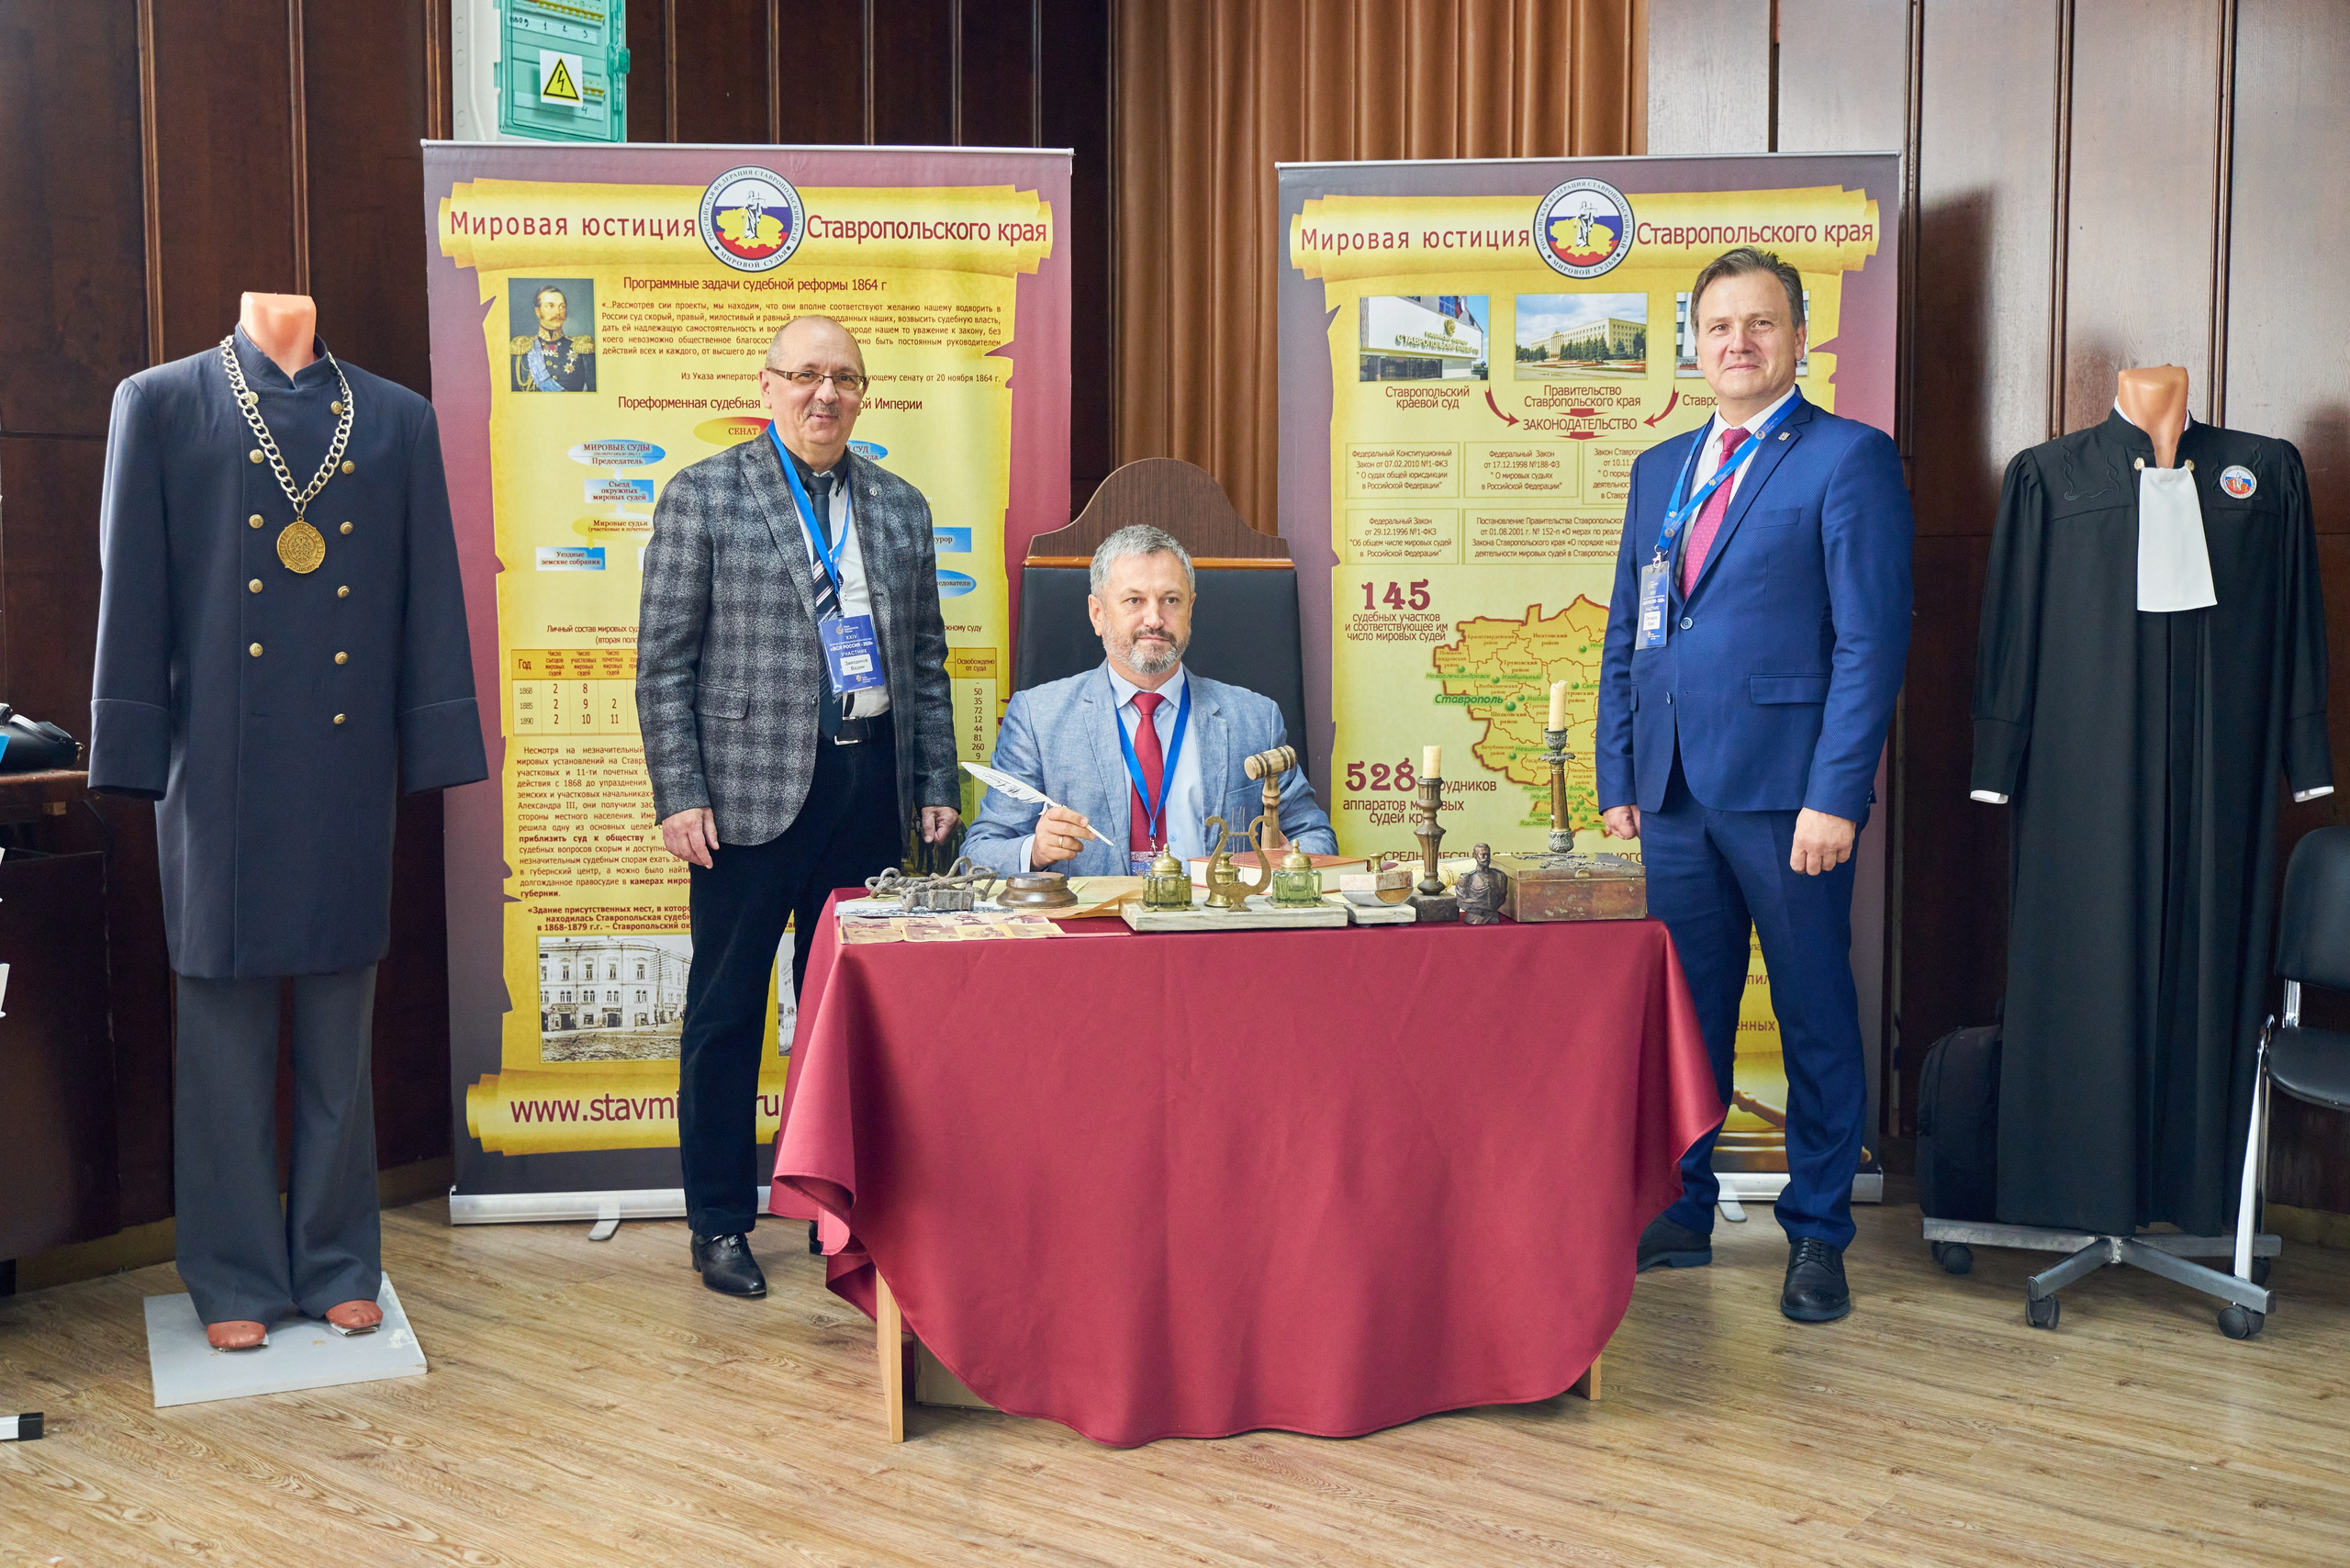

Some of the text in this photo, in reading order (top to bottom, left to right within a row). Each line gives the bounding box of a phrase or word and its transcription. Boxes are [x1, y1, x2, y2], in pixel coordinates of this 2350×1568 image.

[703, 192, 715, 241] РОССИЙСКАЯ
[714, 170, 753, 191] ФЕДЕРАЦИЯ
[755, 171, 800, 220] СТАВРОПОЛЬСКИЙ
[1538, 204, 1550, 250] РОССИЙСКАЯ
[1549, 182, 1586, 202] ФЕДЕРАЦИЯ
[1588, 182, 1630, 230] СТАВРОПОЛЬСКИЙ
[451, 210, 1046, 246] Мировая юстиция Ставропольского края
[1302, 223, 1873, 254] Мировая юстиция Ставропольского края
[720, 250, 788, 268] МИРОВОЙ СУДЬЯ
[1551, 256, 1617, 275] МИРОВОЙ СУДЬЯ
[624, 277, 887, 293] Программные задачи судебной реформы 1864 г
[830, 304, 883, 312] соответствуют
[644, 313, 674, 321] скорый,
[677, 313, 707, 321] правый,
[764, 314, 790, 322] равный
[938, 315, 972, 324] судебную
[717, 372, 758, 381] императора
[948, 374, 973, 383] ноября
[1385, 386, 1470, 400] Ставропольский
[1544, 386, 1621, 397] Правительство
[619, 397, 922, 412] Пореформенная судебная Империи
[1396, 397, 1460, 409] краевой суд
[1524, 396, 1641, 409] Ставропольского края
[1523, 418, 1638, 432] ЗАКОНОДАТЕЛЬСТВО
[728, 426, 758, 436] СЕНАТ
[1352, 449, 1451, 458] Федеральный Конституционный
[1489, 450, 1532, 459] Федеральный
[592, 457, 643, 465] Председатель
[1370, 518, 1412, 526] Федеральный
[1526, 517, 1572, 525] Правительства
[1495, 539, 1550, 547] Ставропольского
[569, 558, 600, 566] собрания
[1361, 578, 1430, 610] 145
[1353, 611, 1440, 623] судебных участков
[1353, 623, 1434, 633] соответствующее
[1376, 633, 1416, 643] мировых
[1419, 631, 1446, 643] судей
[519, 659, 532, 670] Год
[1435, 695, 1504, 706] Ставрополь
[582, 714, 619, 724] 10 11
[1345, 757, 1416, 791] 528
[517, 779, 551, 788] действия
[518, 802, 561, 811] Александра
[566, 801, 577, 810] III,
[1343, 800, 1406, 814] аппаратов
[1370, 810, 1404, 825] судей
[520, 834, 566, 844] приблизить
[606, 834, 643, 842] обществу
[520, 890, 561, 899] губернии.
[528, 906, 631, 914] «Здание присутственных
